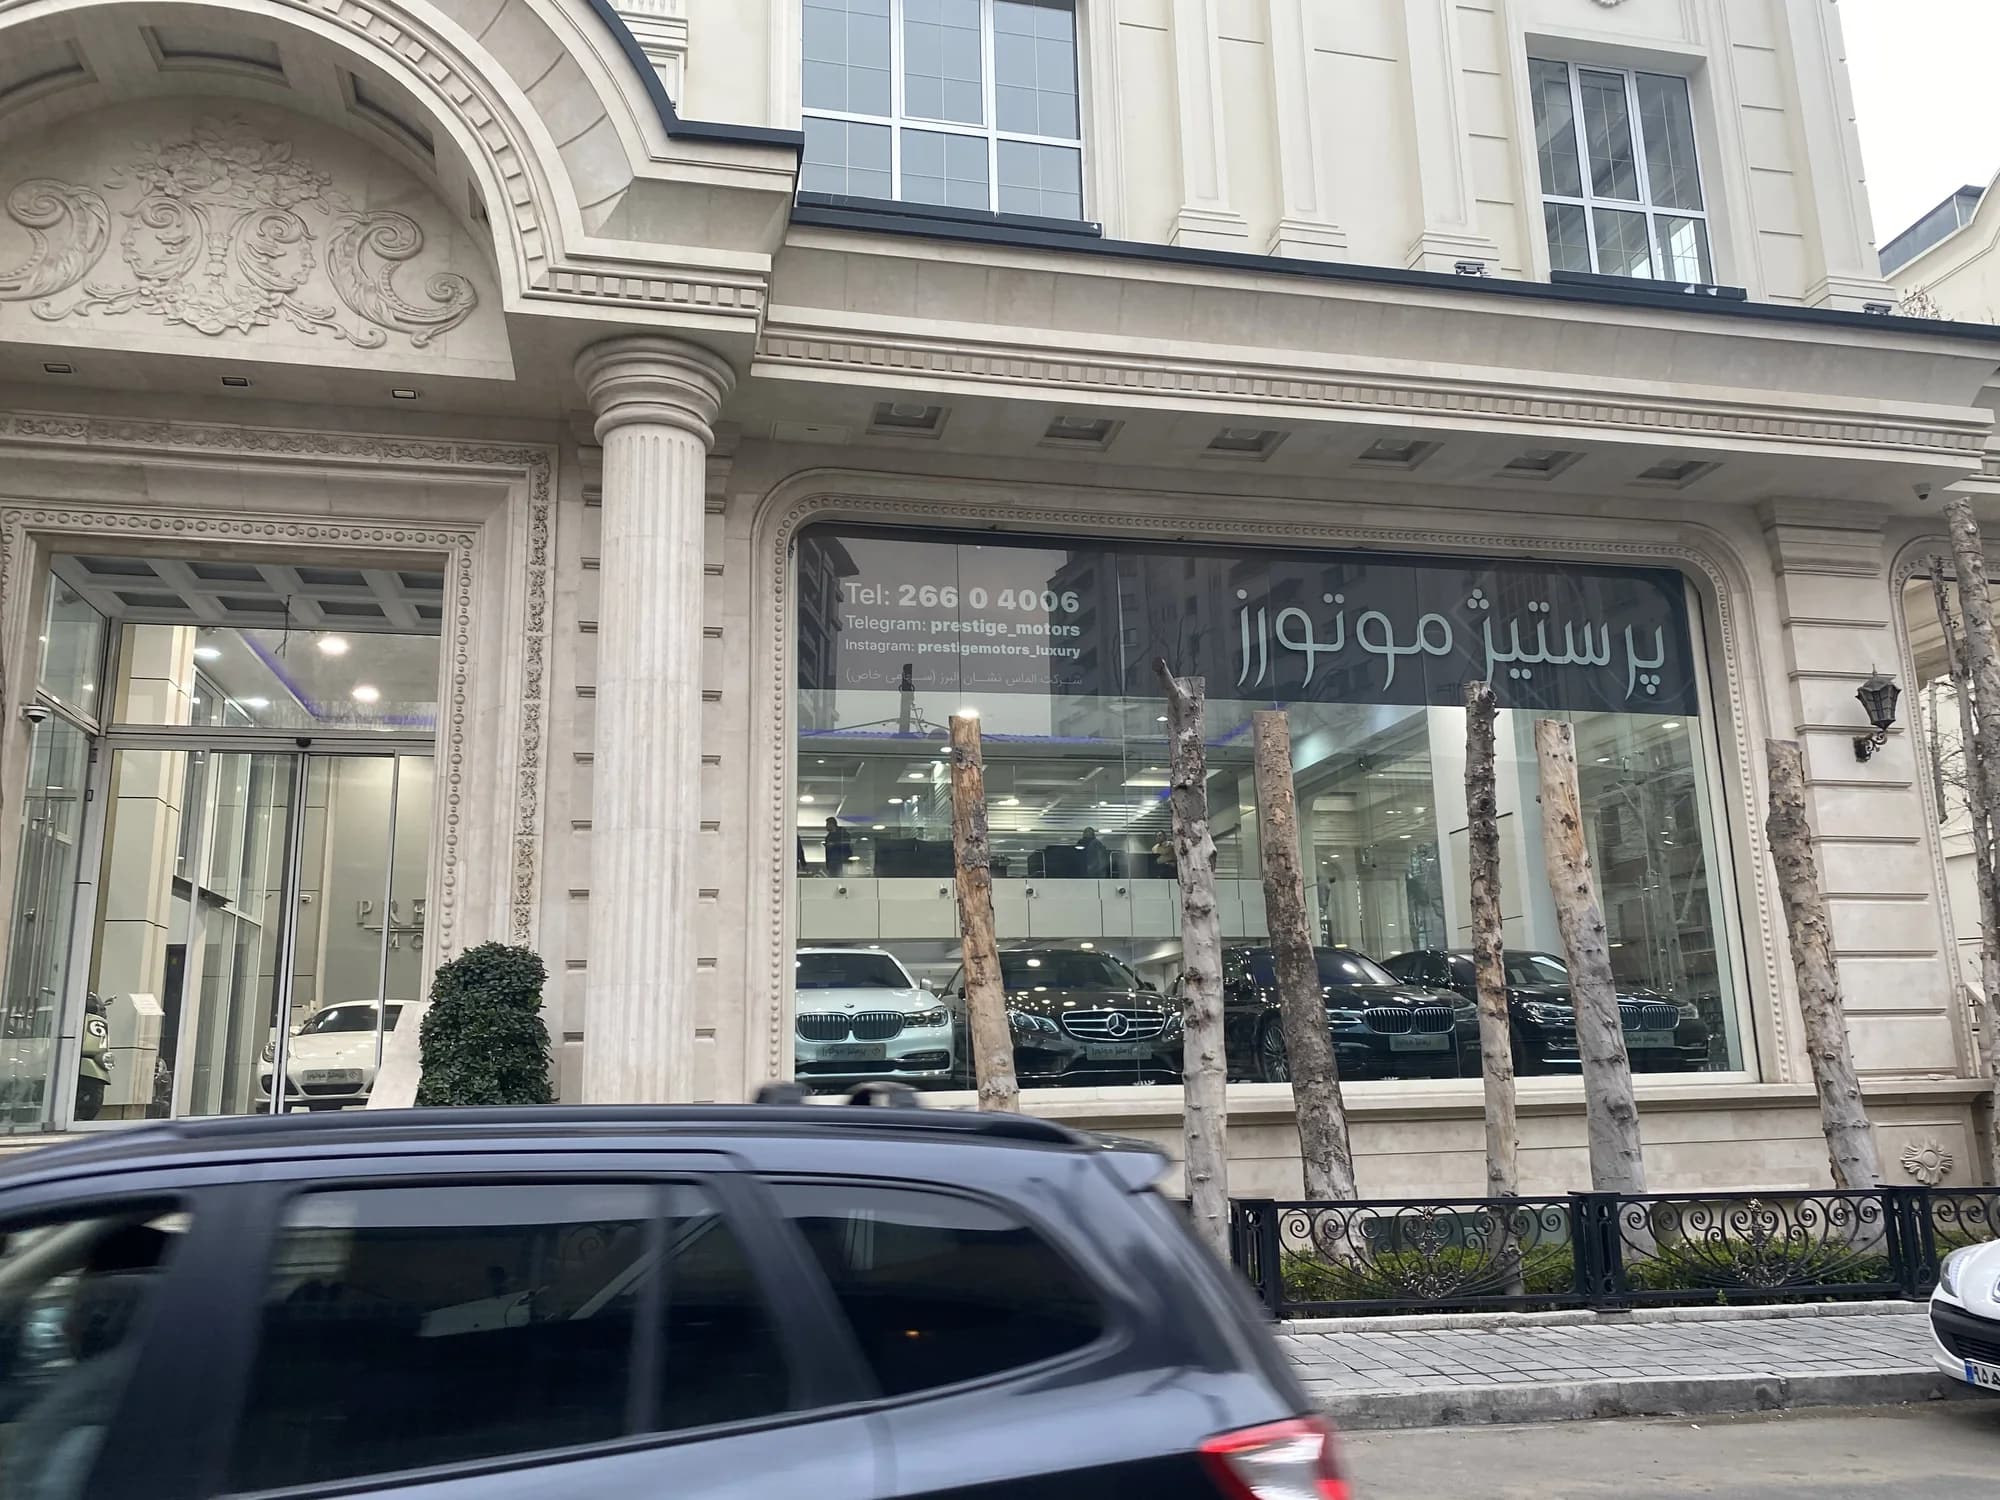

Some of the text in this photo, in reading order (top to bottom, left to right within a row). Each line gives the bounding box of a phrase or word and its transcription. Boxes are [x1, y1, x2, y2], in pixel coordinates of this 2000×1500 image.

[845, 582, 1080, 613] Tel: 266 0 4006
[846, 615, 1080, 637] Telegram: prestige_motors
[845, 639, 1080, 659] Instagram: prestigemotors_luxury
[1235, 588, 1666, 701] پرستیژ موتورز
